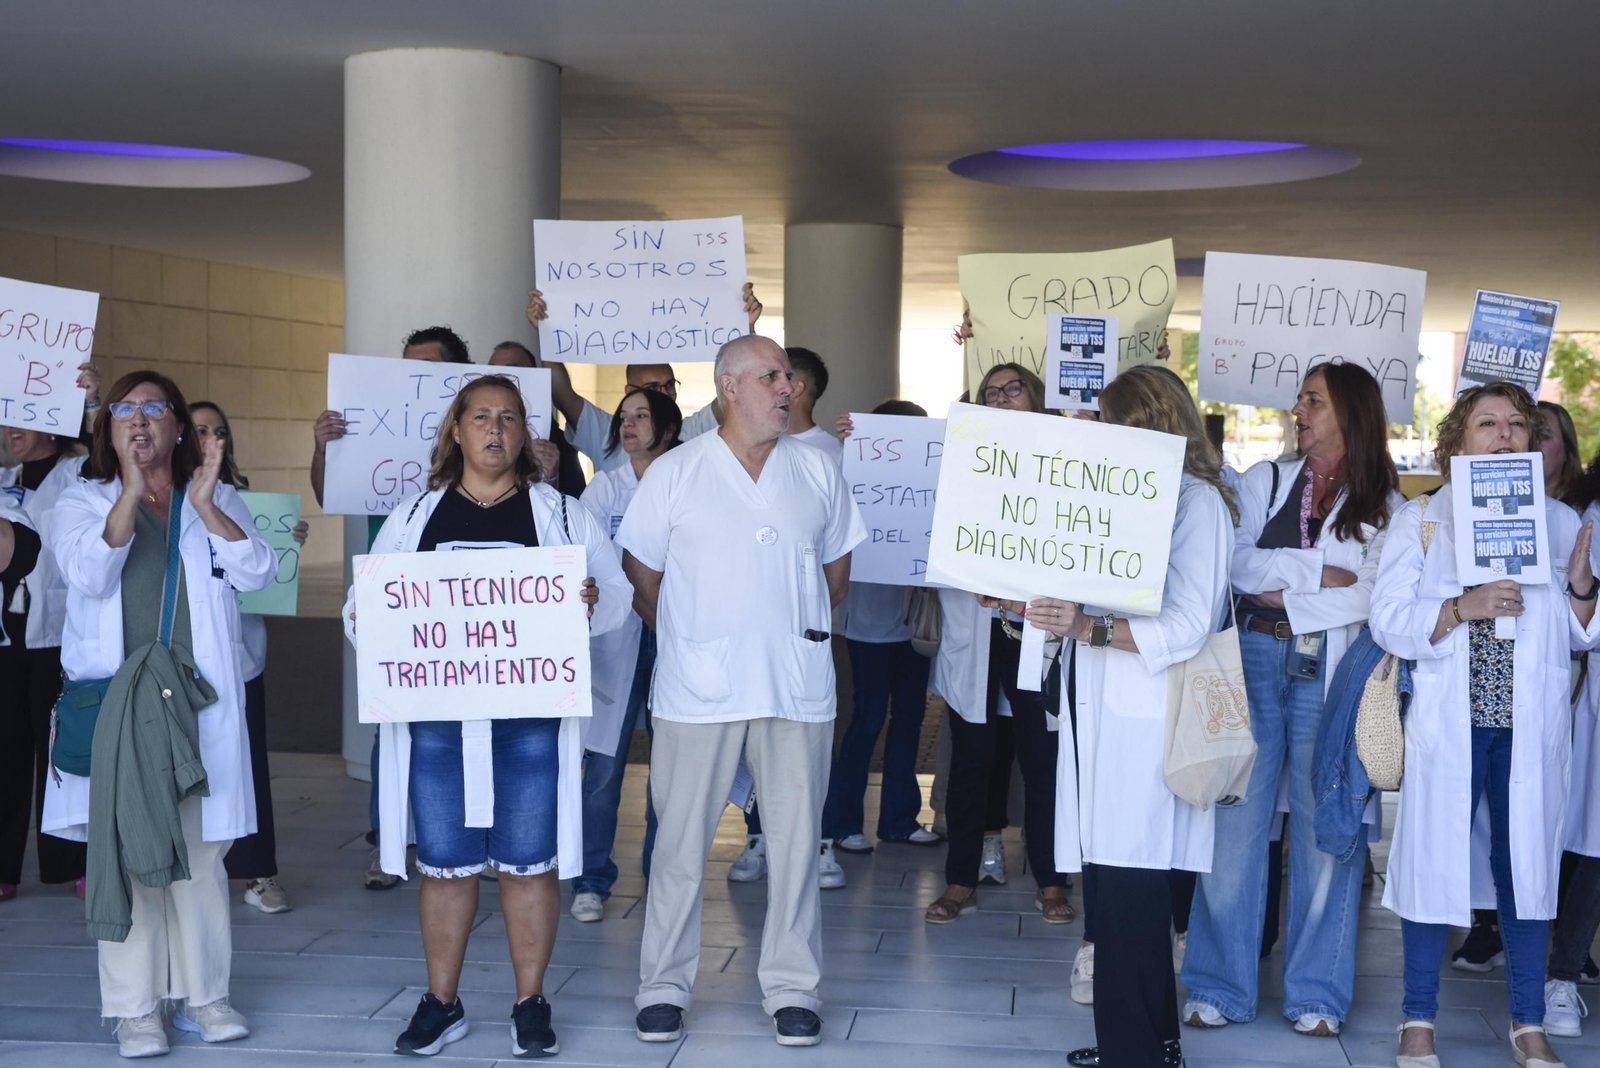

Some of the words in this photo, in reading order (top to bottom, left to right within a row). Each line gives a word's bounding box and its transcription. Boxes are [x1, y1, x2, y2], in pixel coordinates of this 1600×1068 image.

[613, 225, 664, 250] SIN
[694, 232, 727, 246] TSS
[548, 260, 727, 281] NOSOTROS
[1008, 265, 1169, 320] GRADO
[1234, 278, 1406, 333] HACIENDA
[574, 301, 620, 318] NO
[652, 297, 709, 318] HAY
[0, 309, 95, 352] GRUPO
[1062, 333, 1088, 345] HUELGA
[1090, 334, 1103, 346] TSS
[1215, 338, 1245, 347] GRUPO
[1468, 341, 1517, 366] HUELGA
[1519, 349, 1542, 370] TSS
[1060, 376, 1087, 389] HUELGA
[1089, 378, 1102, 389] TSS
[1251, 352, 1345, 387] PA
[1367, 357, 1408, 400] YA
[853, 437, 903, 461] TSS
[972, 442, 1018, 478] SIN
[1032, 450, 1157, 500] TÉCNICOS
[1473, 481, 1510, 497] HUELGA
[1512, 480, 1531, 495] TSS
[1002, 493, 1037, 525] NO
[1055, 501, 1111, 537] HAY
[872, 529, 910, 543] DEL
[1476, 541, 1513, 557] HUELGA
[1516, 540, 1534, 556] TSS
[956, 523, 1142, 580] DIAGNÓSTICO
[384, 575, 430, 609] SIN
[439, 570, 565, 607] TÉCNICOS
[413, 622, 446, 648] NO
[465, 620, 517, 648] HAY
[378, 654, 576, 688] TRATAMIENTOS
